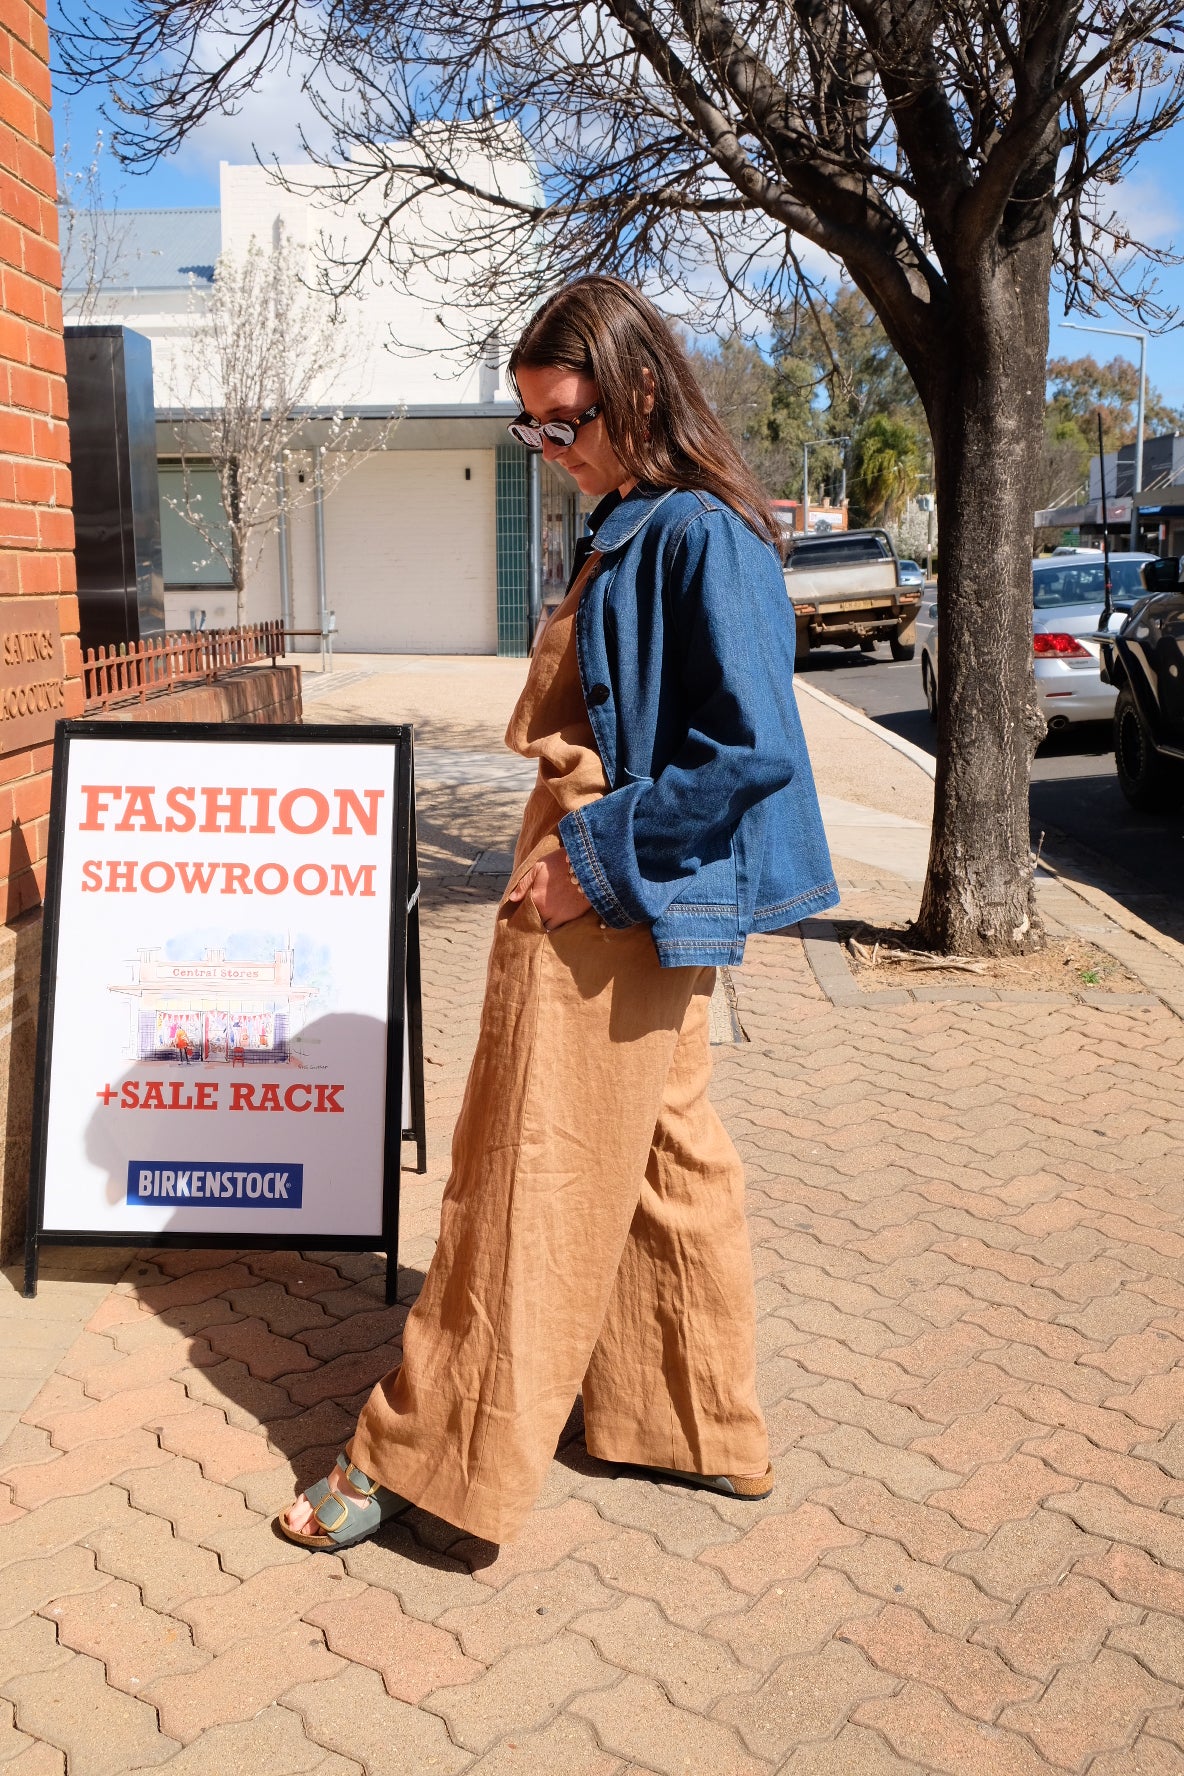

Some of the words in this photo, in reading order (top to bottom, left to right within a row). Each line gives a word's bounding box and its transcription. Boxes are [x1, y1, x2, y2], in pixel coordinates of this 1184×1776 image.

[3, 630, 53, 666] SAVINGS
[78, 785, 385, 836] FASHION
[81, 859, 377, 897] SHOWROOM
[172, 967, 217, 977] Central
[220, 968, 260, 978] Stores
[96, 1080, 218, 1111] +SALE
[229, 1083, 345, 1113] RACK
[138, 1170, 289, 1199] BIRKENSTOCK
